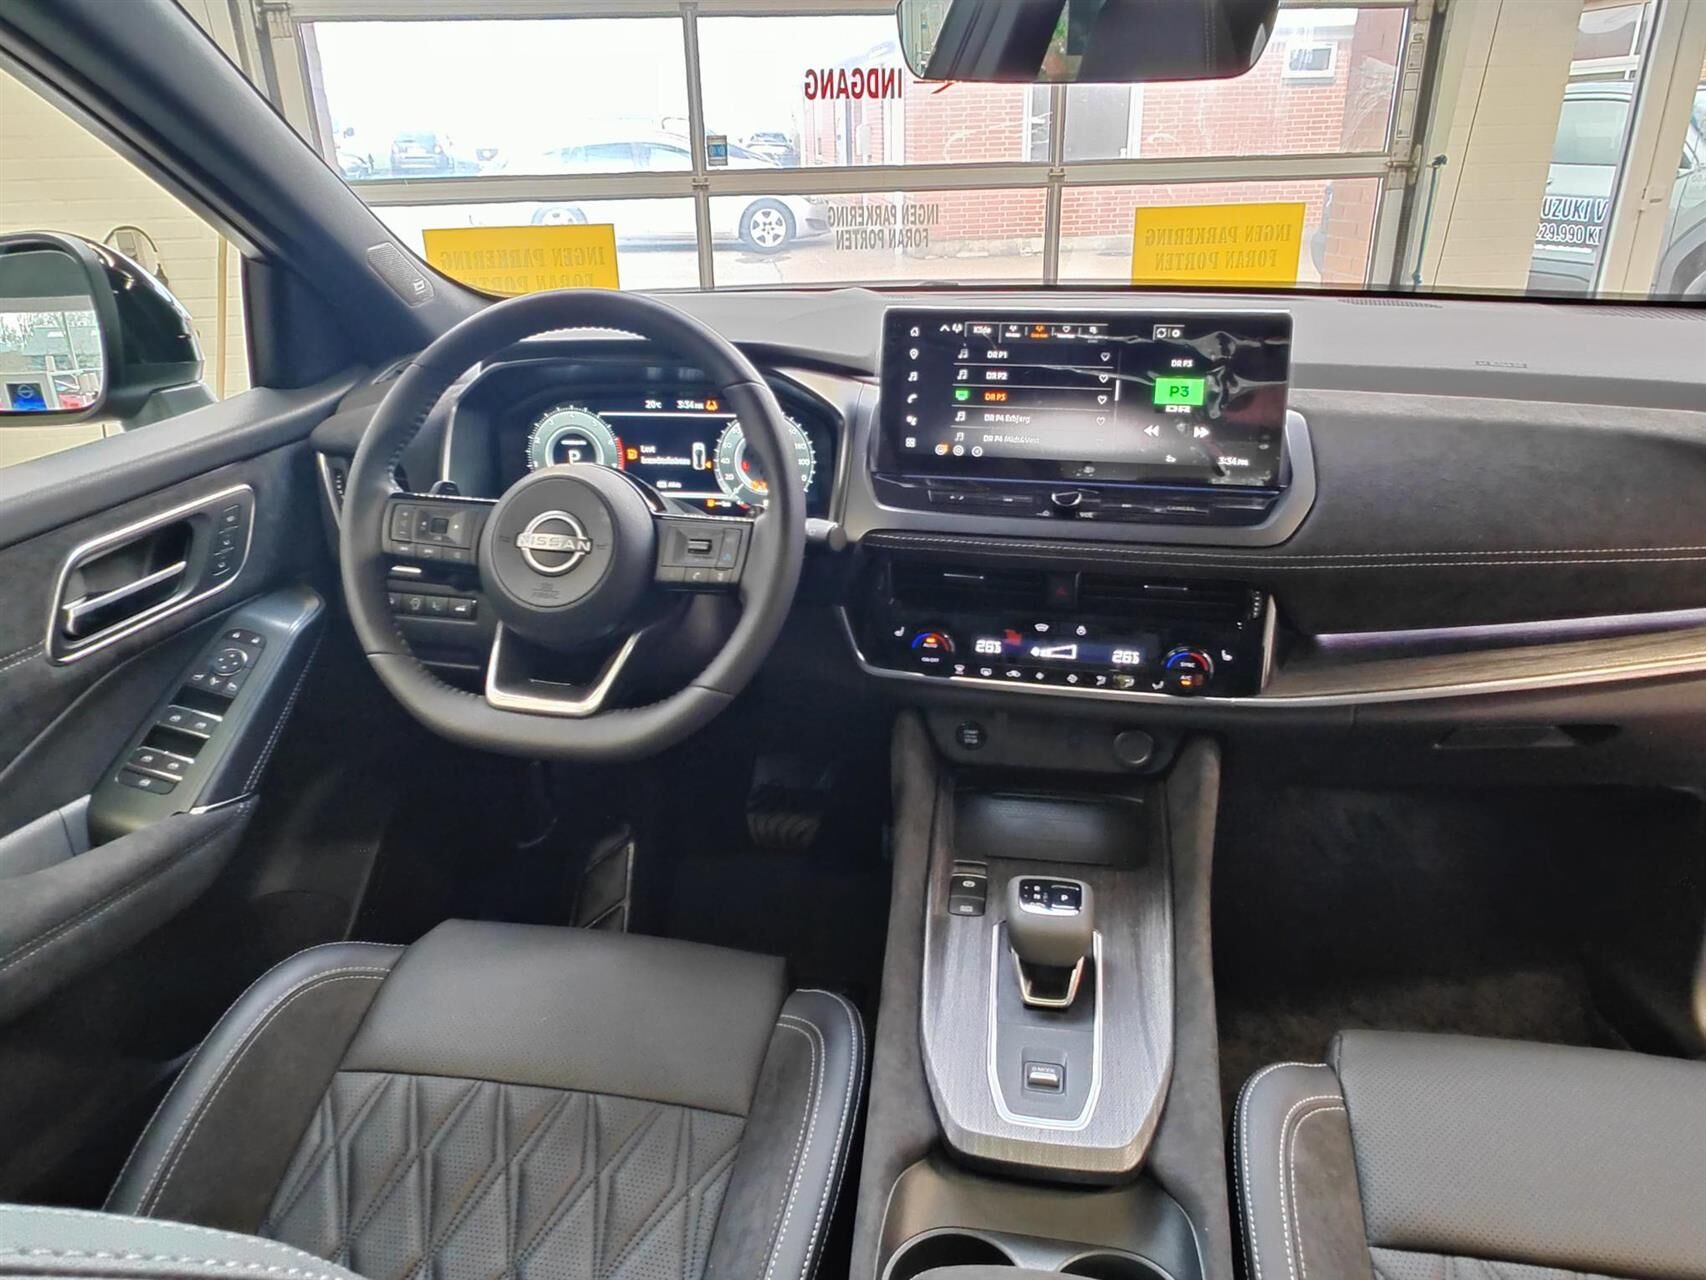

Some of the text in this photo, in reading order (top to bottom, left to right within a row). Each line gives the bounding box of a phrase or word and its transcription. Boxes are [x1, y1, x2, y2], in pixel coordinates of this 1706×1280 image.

[1542, 198, 1590, 220] UZUKI
[1169, 385, 1190, 398] P3
[517, 534, 592, 552] NISSAN
